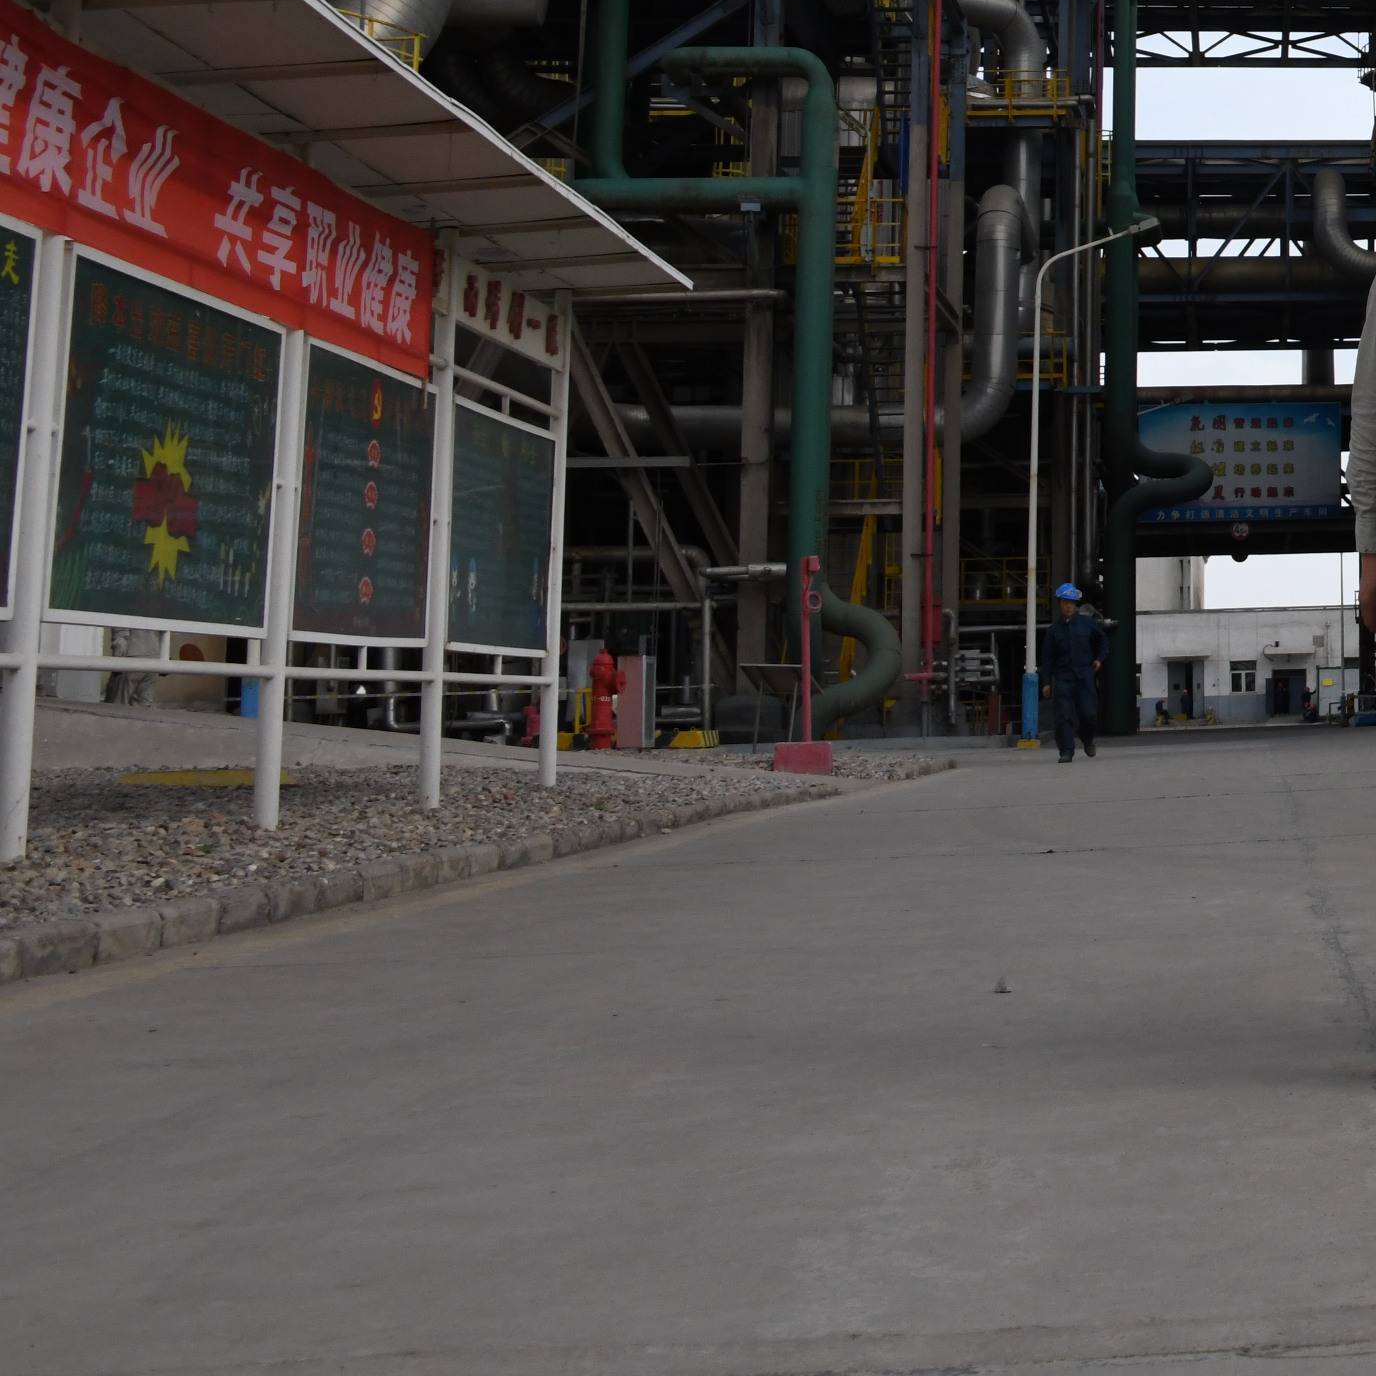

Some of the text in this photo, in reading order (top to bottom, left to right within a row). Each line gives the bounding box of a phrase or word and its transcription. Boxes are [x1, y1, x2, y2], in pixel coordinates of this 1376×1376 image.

[214, 165, 421, 345] 共享职业健康
